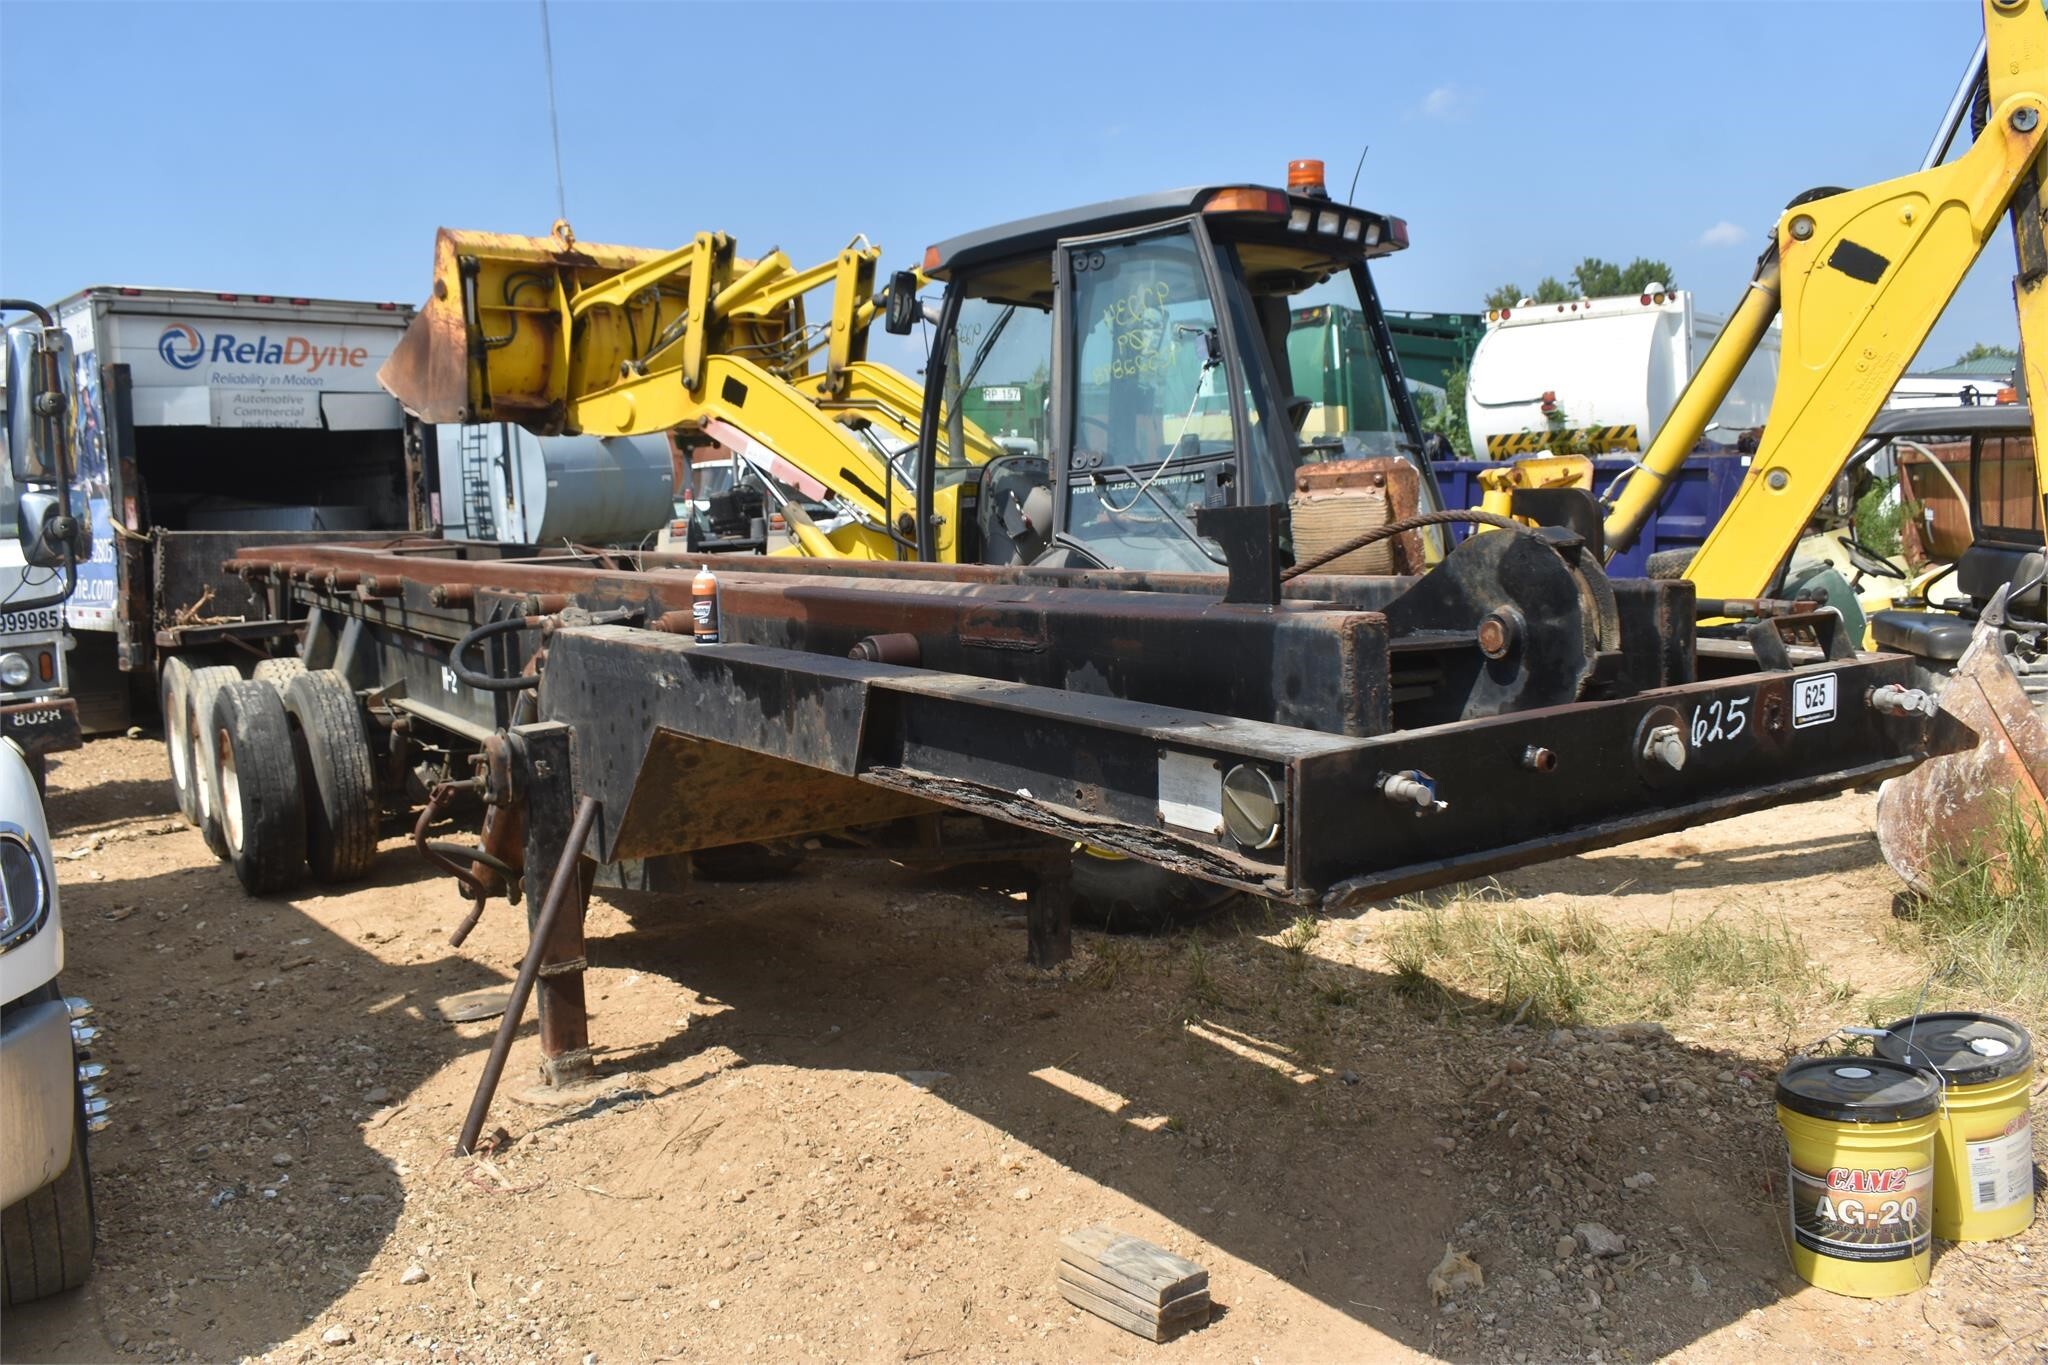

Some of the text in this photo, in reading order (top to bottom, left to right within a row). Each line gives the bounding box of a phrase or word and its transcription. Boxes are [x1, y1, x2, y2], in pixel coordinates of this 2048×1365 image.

[211, 333, 369, 372] RelaDyne
[211, 372, 324, 386] Reliability in Motion
[233, 393, 304, 405] Automotive
[233, 406, 305, 417] Commercial
[1805, 683, 1826, 709] 625
[1692, 696, 1751, 747] 625
[1826, 1167, 1909, 1193] CAM2
[1815, 1195, 1919, 1225] AG-20
